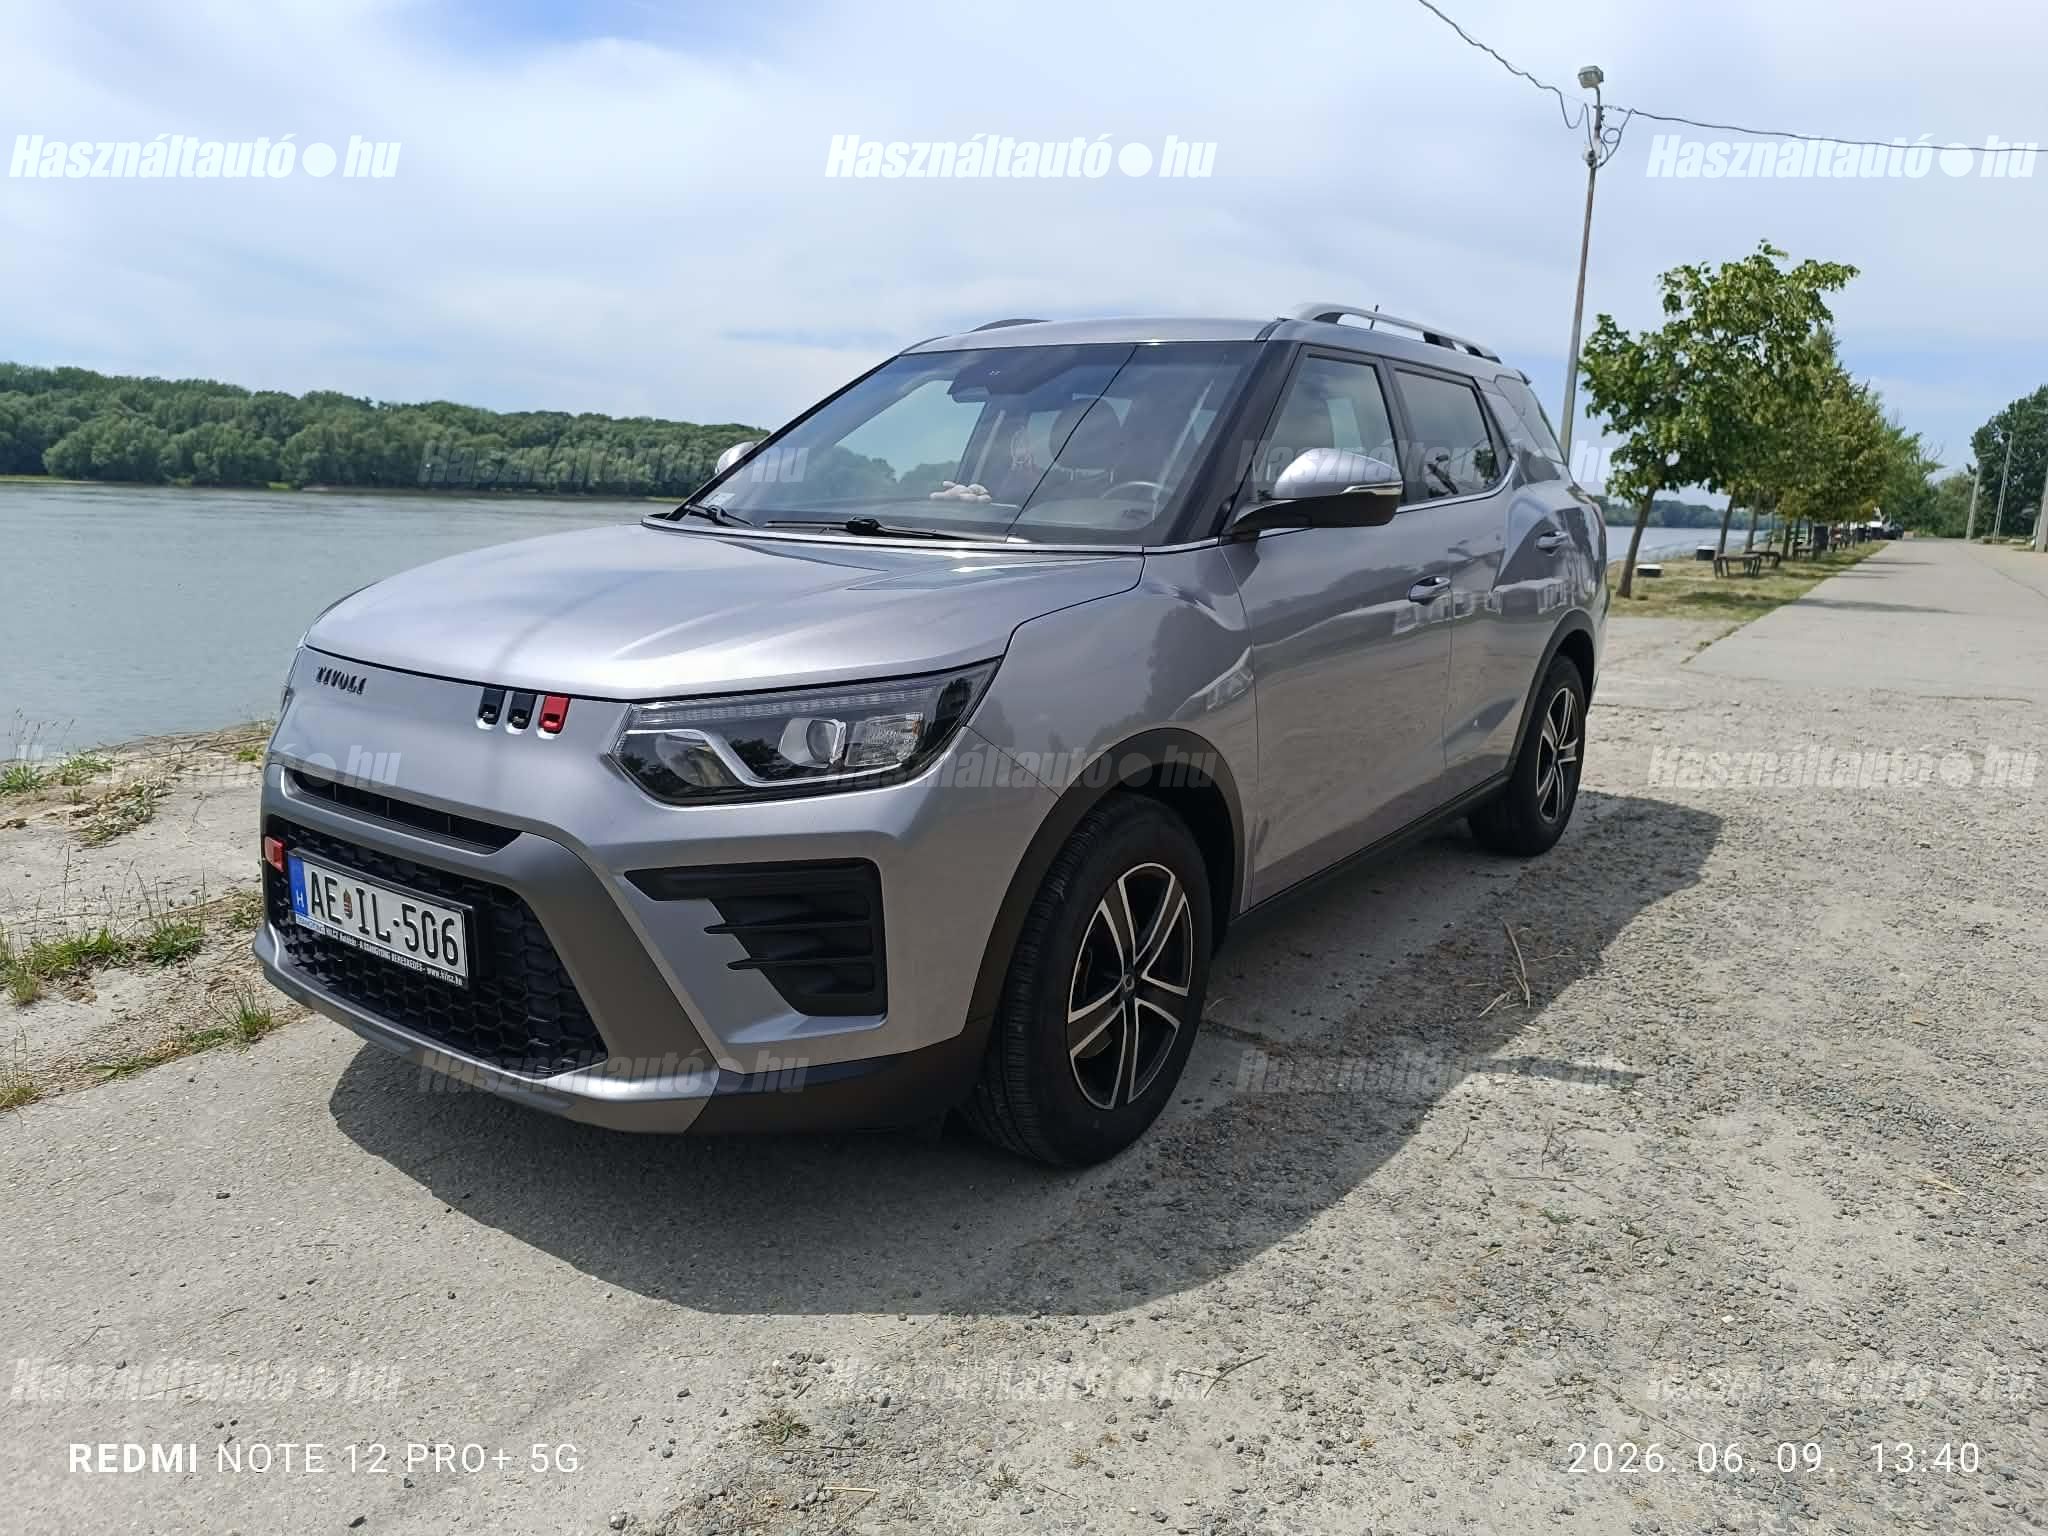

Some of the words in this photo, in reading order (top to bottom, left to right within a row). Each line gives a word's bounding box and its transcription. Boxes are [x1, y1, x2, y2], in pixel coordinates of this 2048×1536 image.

[315, 666, 367, 695] TIVOLI
[296, 890, 305, 908] H
[311, 871, 343, 925] AE
